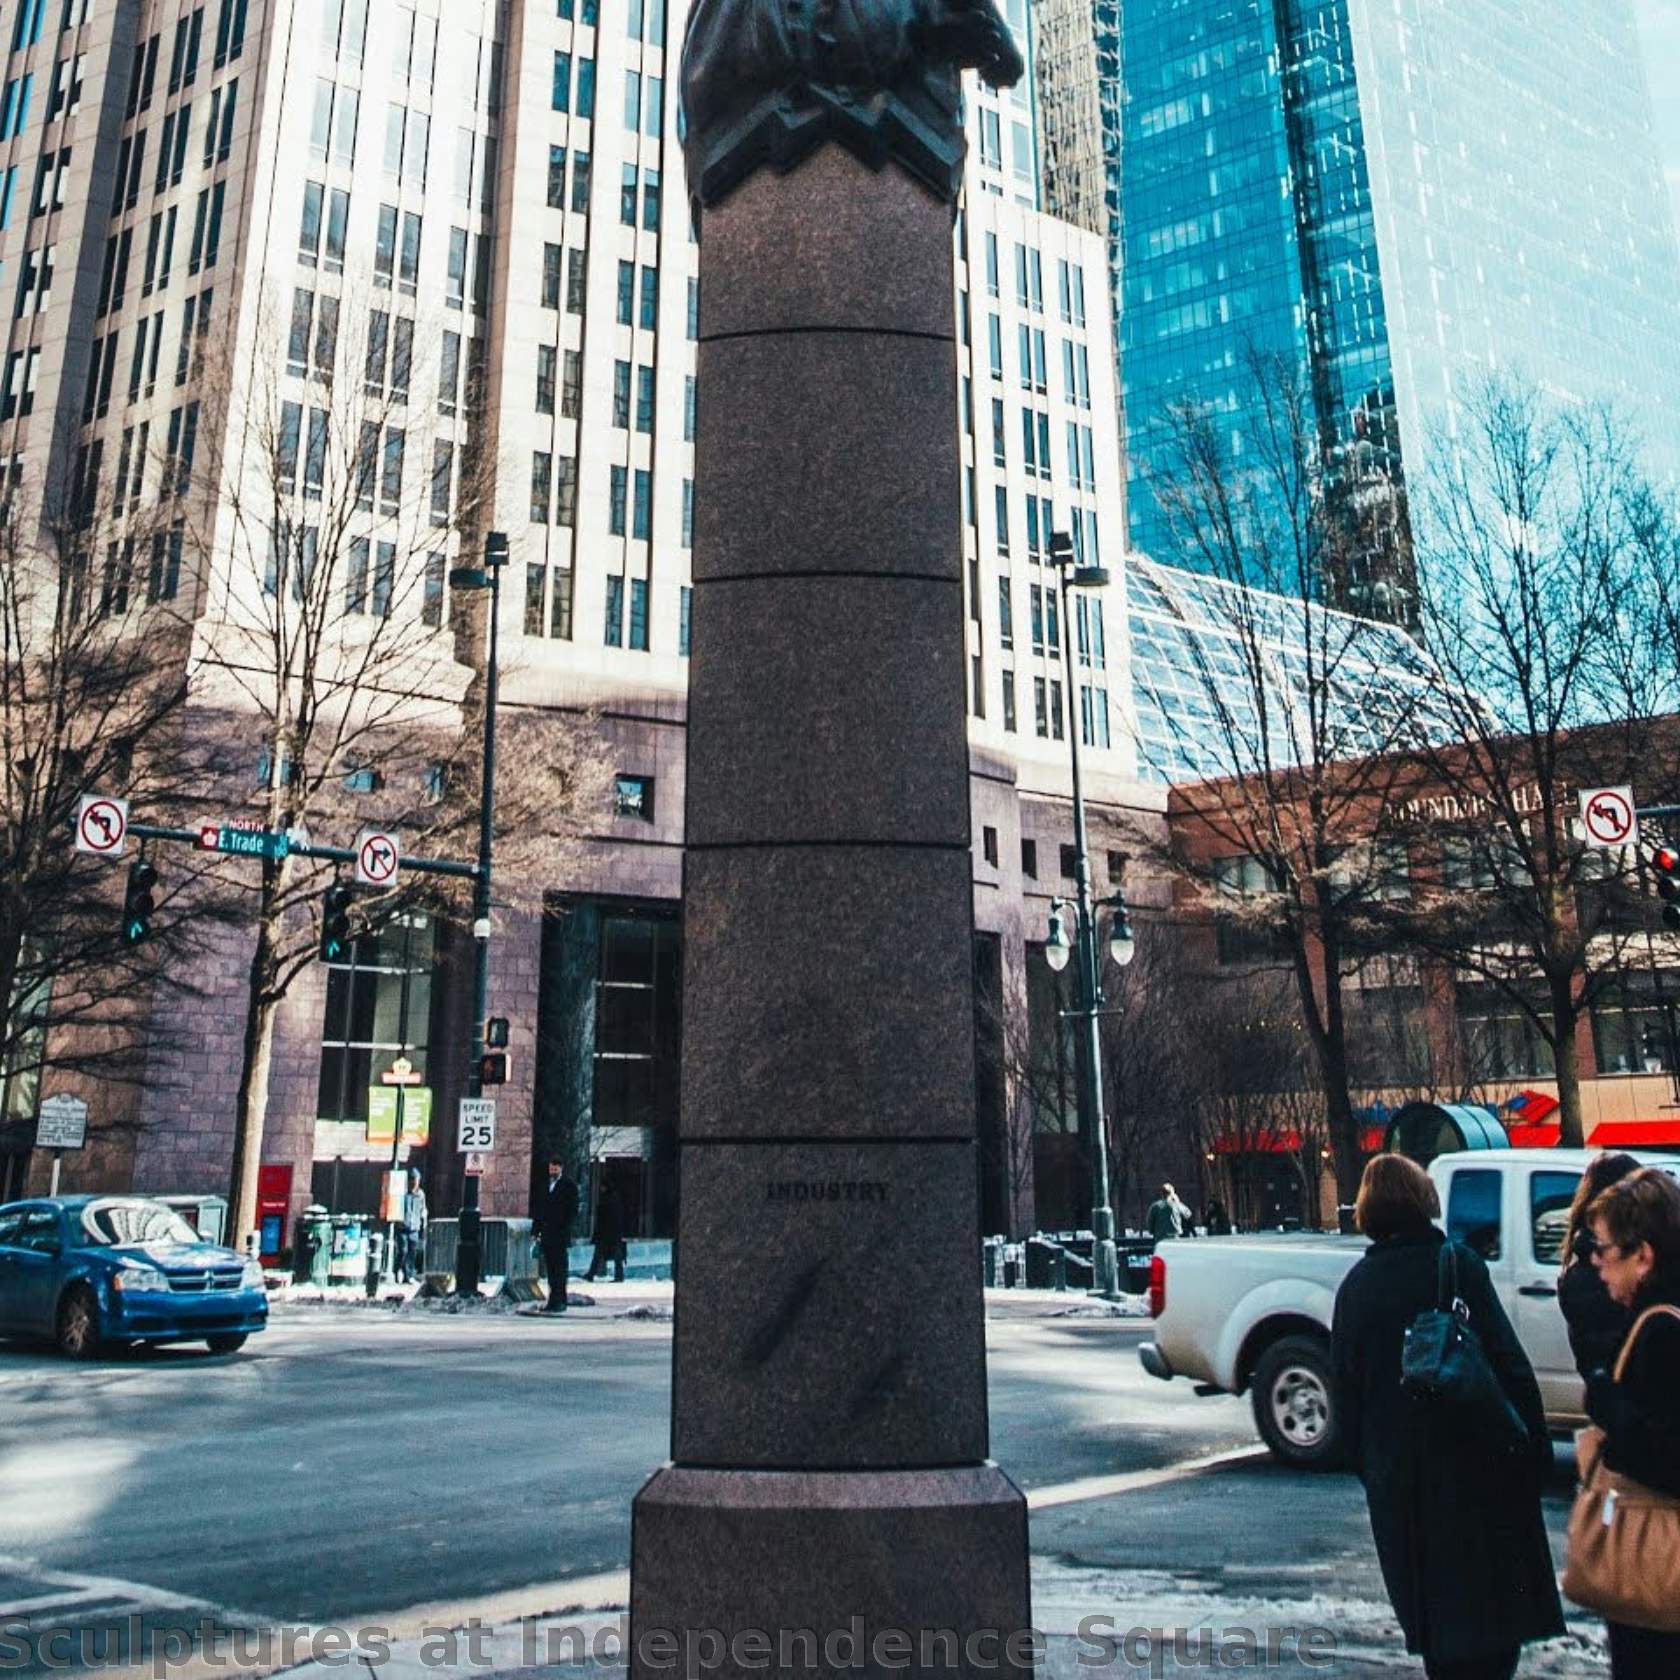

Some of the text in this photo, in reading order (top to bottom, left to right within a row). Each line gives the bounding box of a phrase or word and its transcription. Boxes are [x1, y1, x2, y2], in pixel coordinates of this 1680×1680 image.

[1511, 781, 1578, 812] HAL
[228, 819, 265, 833] NORTH
[218, 830, 229, 849] E.
[230, 832, 265, 853] Trade
[463, 1103, 493, 1113] SPEED
[465, 1115, 489, 1124] LIMIT
[461, 1126, 491, 1146] 25
[767, 1181, 890, 1202] INDUSTRY
